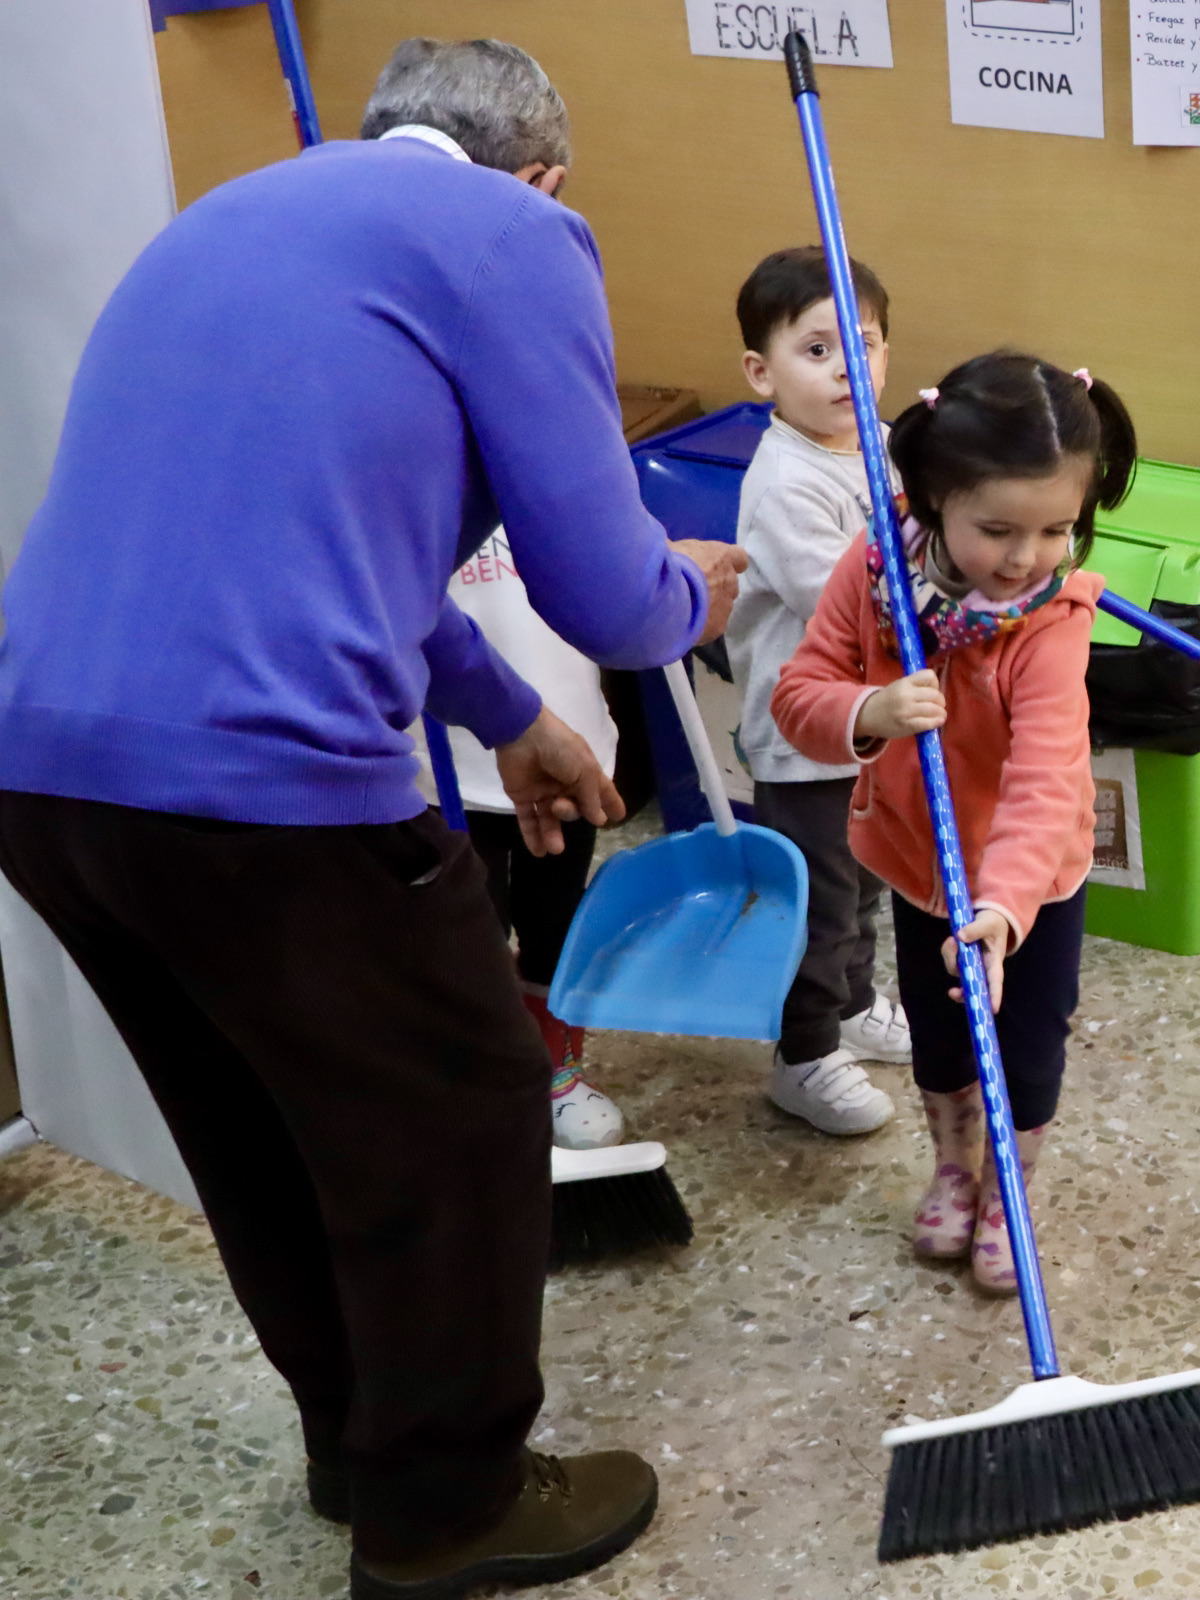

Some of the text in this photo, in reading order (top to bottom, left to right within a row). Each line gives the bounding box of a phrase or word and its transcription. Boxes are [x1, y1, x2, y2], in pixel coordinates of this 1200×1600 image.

[1148, 12, 1185, 28] Fregar
[1146, 32, 1185, 45] Reciclar
[1190, 40, 1196, 50] y
[1143, 52, 1185, 68] Barrer
[1192, 63, 1198, 73] y
[978, 66, 1073, 95] COCINA
